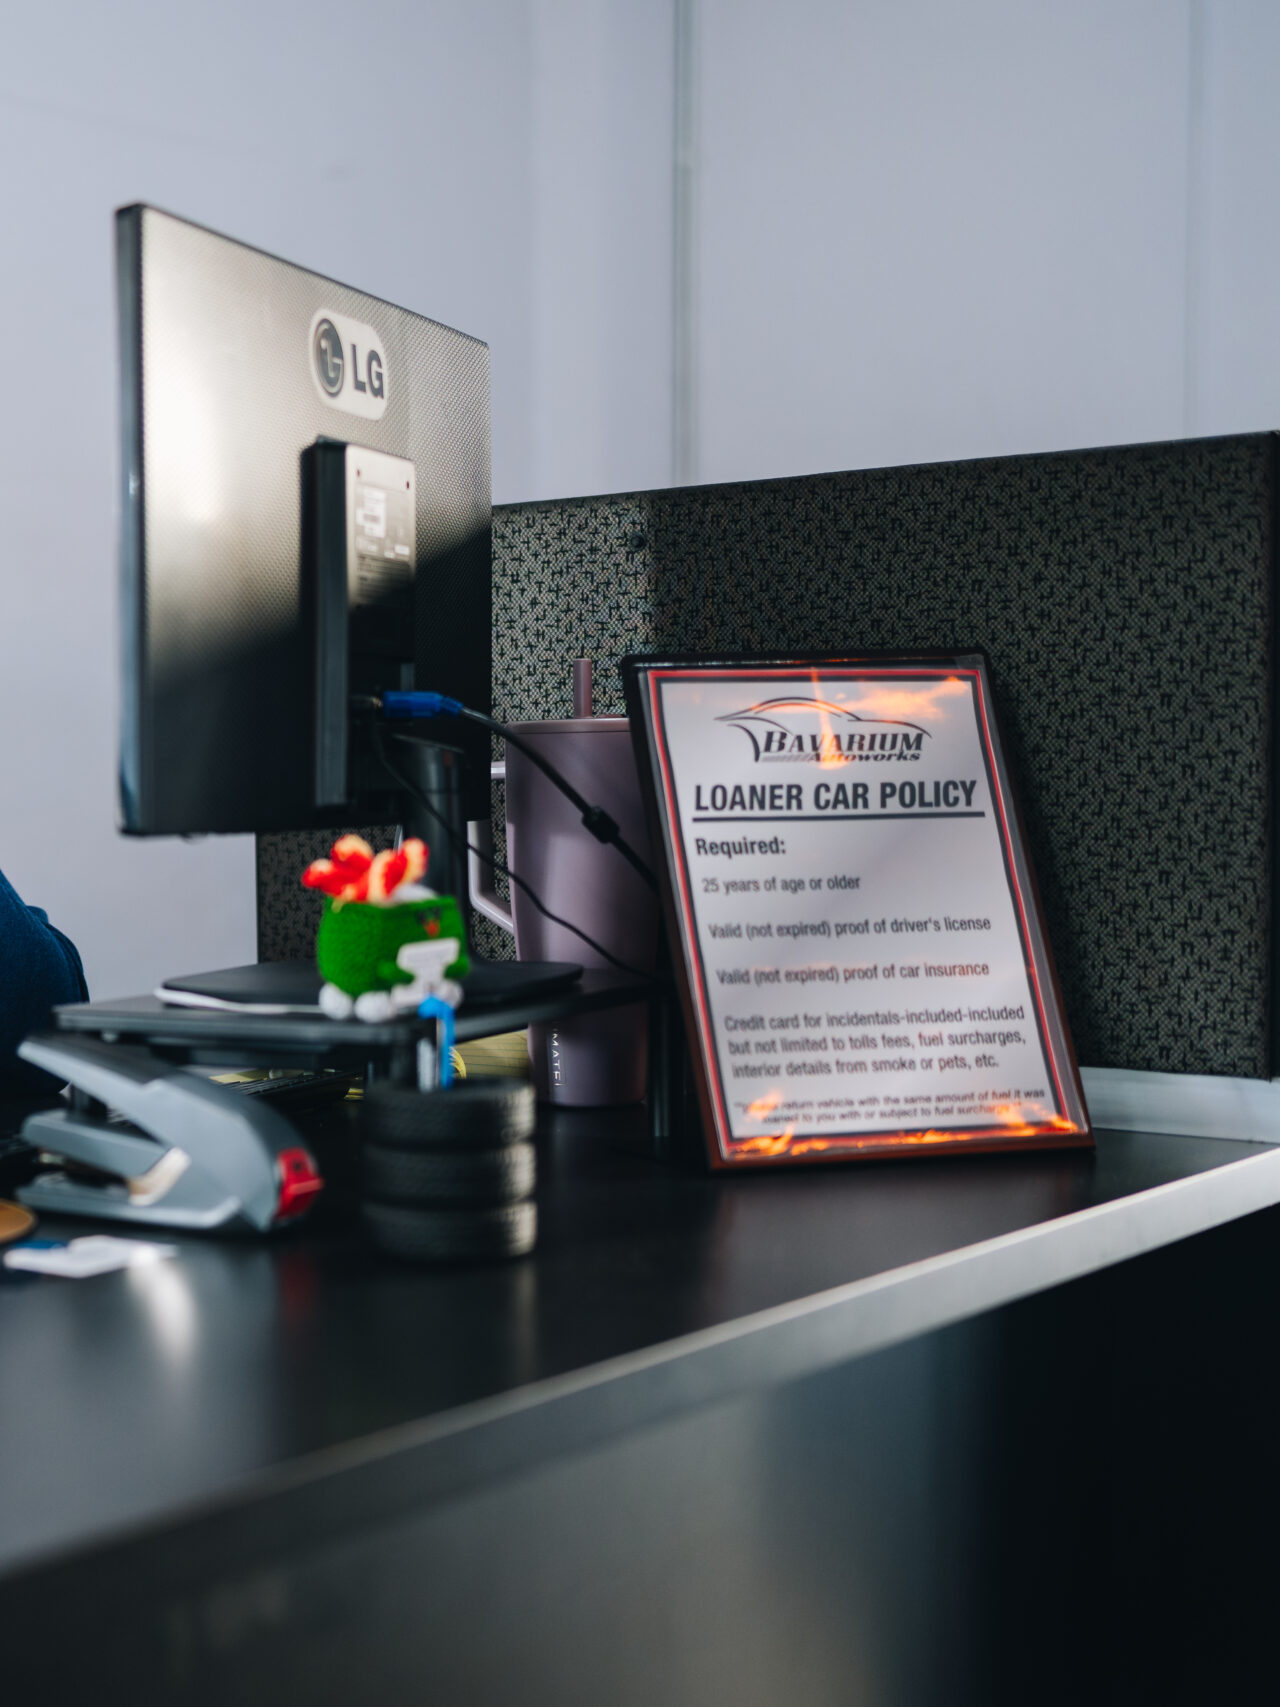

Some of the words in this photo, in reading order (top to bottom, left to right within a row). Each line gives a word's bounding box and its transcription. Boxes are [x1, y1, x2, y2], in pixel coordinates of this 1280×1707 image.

[351, 343, 385, 399] LG
[694, 784, 802, 811] LOANER
[814, 782, 869, 809] CAR
[880, 779, 977, 808] POLICY
[695, 837, 786, 859] Required:
[702, 878, 720, 892] 25
[722, 878, 760, 894] years
[763, 876, 778, 891] of
[780, 878, 806, 893] age
[808, 877, 824, 889] or
[826, 875, 860, 890] older
[709, 923, 742, 939] Valid
[746, 922, 774, 940] (not
[776, 919, 831, 939] expired)
[835, 919, 869, 937] proof
[873, 918, 887, 935] of
[890, 917, 941, 934] driver's
[944, 916, 991, 932] license
[716, 969, 751, 985] Valid
[755, 968, 782, 986] (not
[785, 966, 839, 985] expired)
[843, 965, 878, 983] proof
[882, 965, 896, 980] of
[899, 966, 920, 979] car
[924, 961, 989, 977] insurance
[725, 1015, 765, 1032] Credit
[769, 1013, 800, 1030] card
[803, 1012, 823, 1028] for
[826, 1006, 1025, 1027] incidentals-included-included
[728, 1039, 751, 1055] but
[754, 1039, 777, 1054] not
[781, 1036, 827, 1052] limited
[832, 1036, 846, 1050] to
[848, 1034, 878, 1050] tolls
[881, 1033, 915, 1050] fees,
[918, 1031, 944, 1047] fuel
[947, 1029, 1026, 1049] surcharges,
[732, 1062, 782, 1079] interior
[786, 1060, 832, 1077] details
[836, 1059, 868, 1075] from
[871, 1057, 916, 1072] smoke
[920, 1058, 934, 1069] or
[937, 1054, 971, 1072] pets,
[975, 1054, 999, 1069] etc.
[858, 1096, 880, 1107] with
[884, 1095, 900, 1105] the
[935, 1093, 976, 1103] amount
[978, 1091, 989, 1101] of
[1024, 1089, 1045, 1099] was
